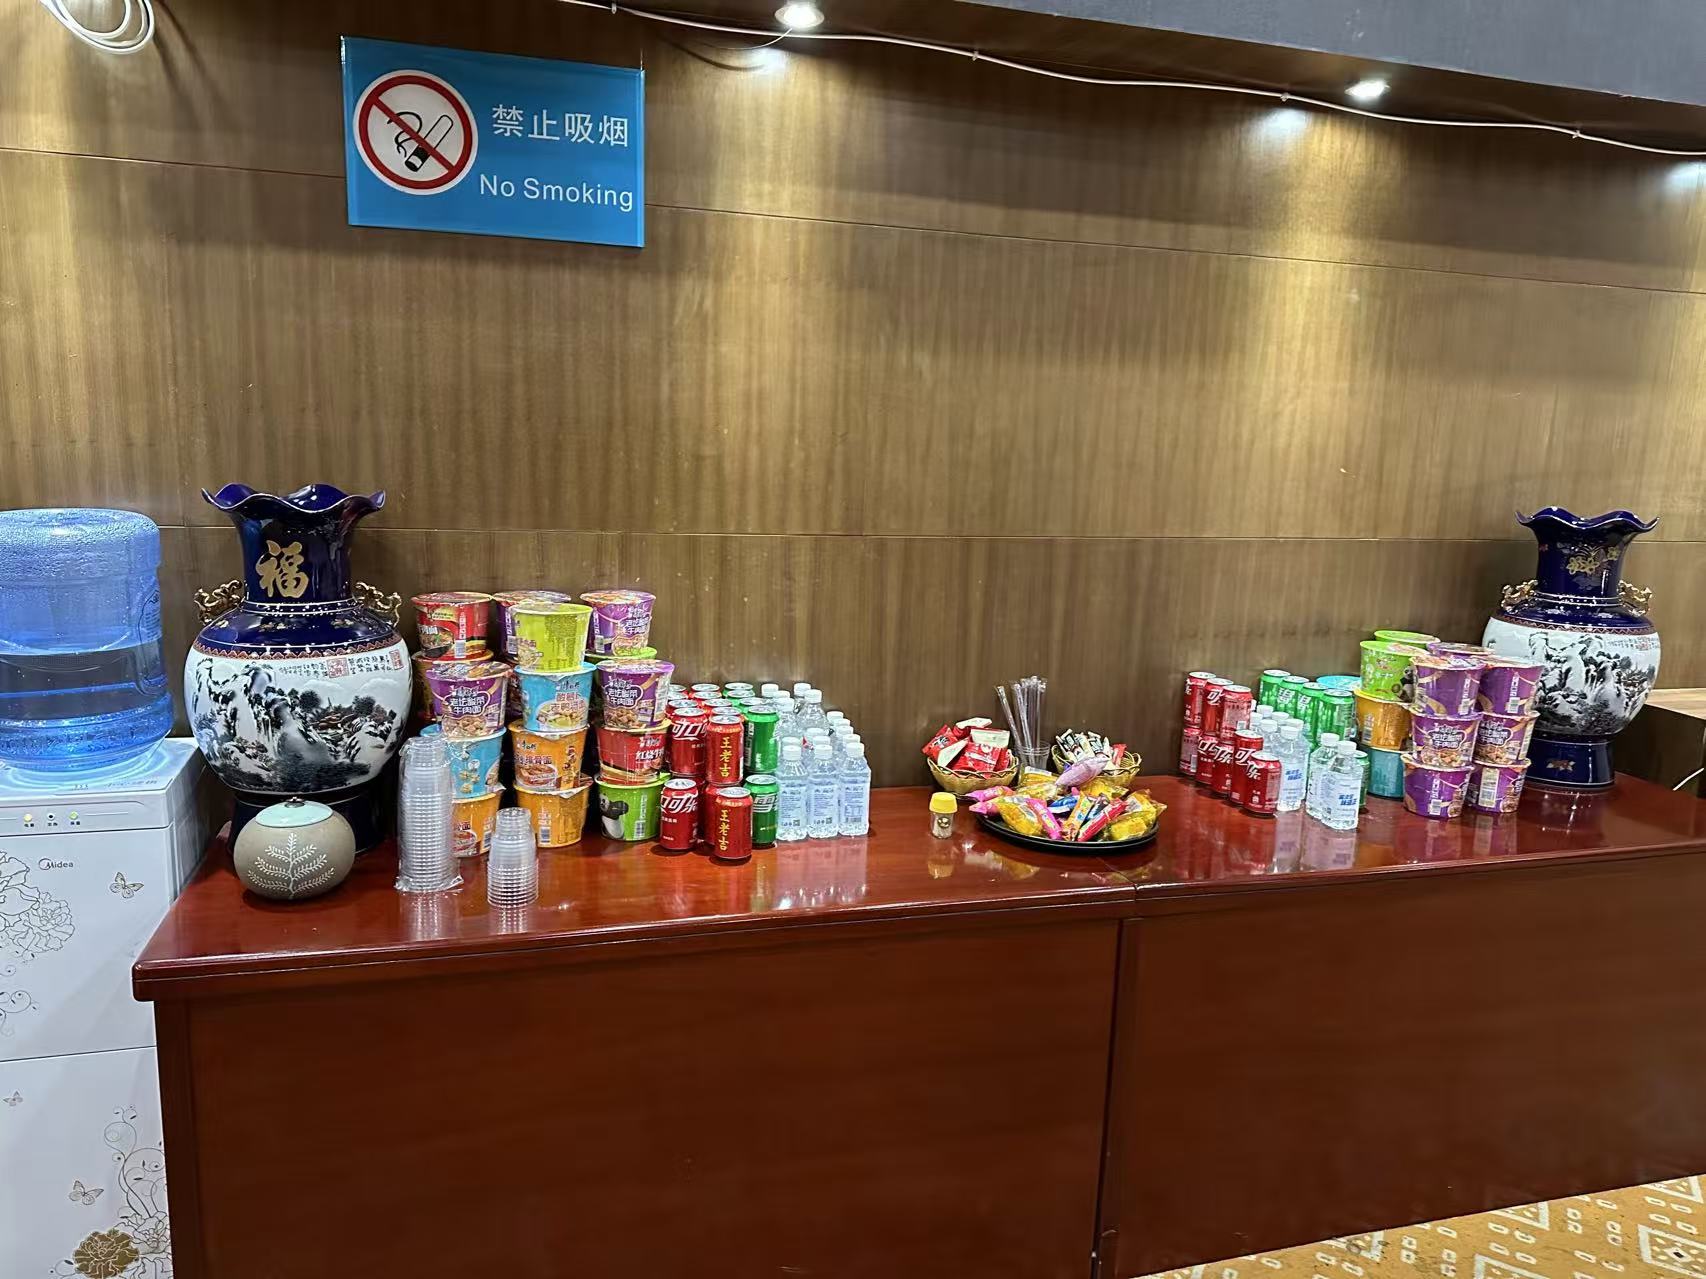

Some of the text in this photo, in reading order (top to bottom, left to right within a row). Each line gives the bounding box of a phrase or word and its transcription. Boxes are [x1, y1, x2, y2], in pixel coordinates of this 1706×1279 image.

[492, 104, 628, 147] 禁止吸烟
[480, 174, 633, 212] No Smoking
[255, 540, 309, 598] 福
[719, 736, 732, 777] 王老吉
[719, 809, 731, 851] 王老吉
[39, 858, 74, 870] Midea
